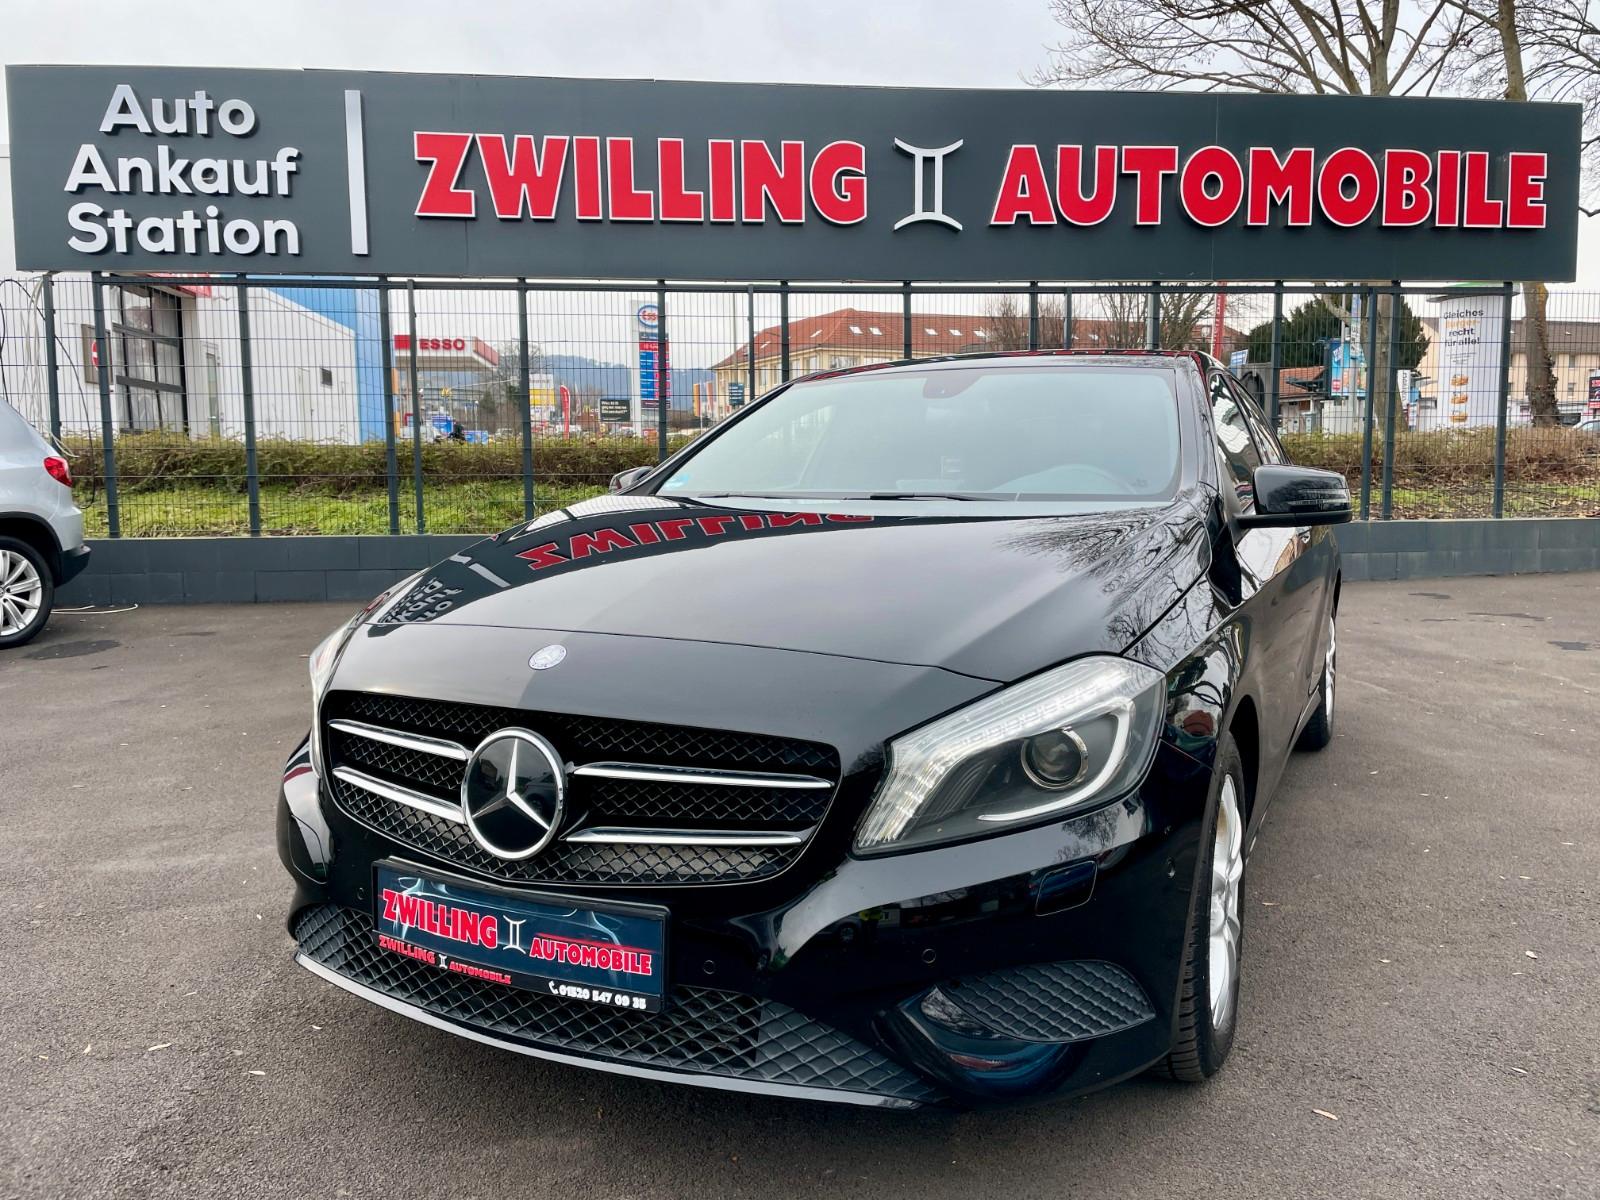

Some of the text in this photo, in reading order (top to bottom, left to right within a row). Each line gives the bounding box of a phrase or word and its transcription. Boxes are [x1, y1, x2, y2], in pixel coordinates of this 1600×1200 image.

[99, 83, 256, 136] Auto
[63, 143, 300, 196] Ankauf
[413, 131, 1549, 230] ZWILLING AUTOMOBILE
[67, 202, 300, 255] Station
[1443, 309, 1484, 319] Gleiches
[1449, 328, 1475, 337] recht
[420, 338, 466, 351] ESSO
[382, 888, 652, 976] ZWILLING AUTOMOBILE
[378, 934, 512, 985] ZWILLING AUTOMOBILE
